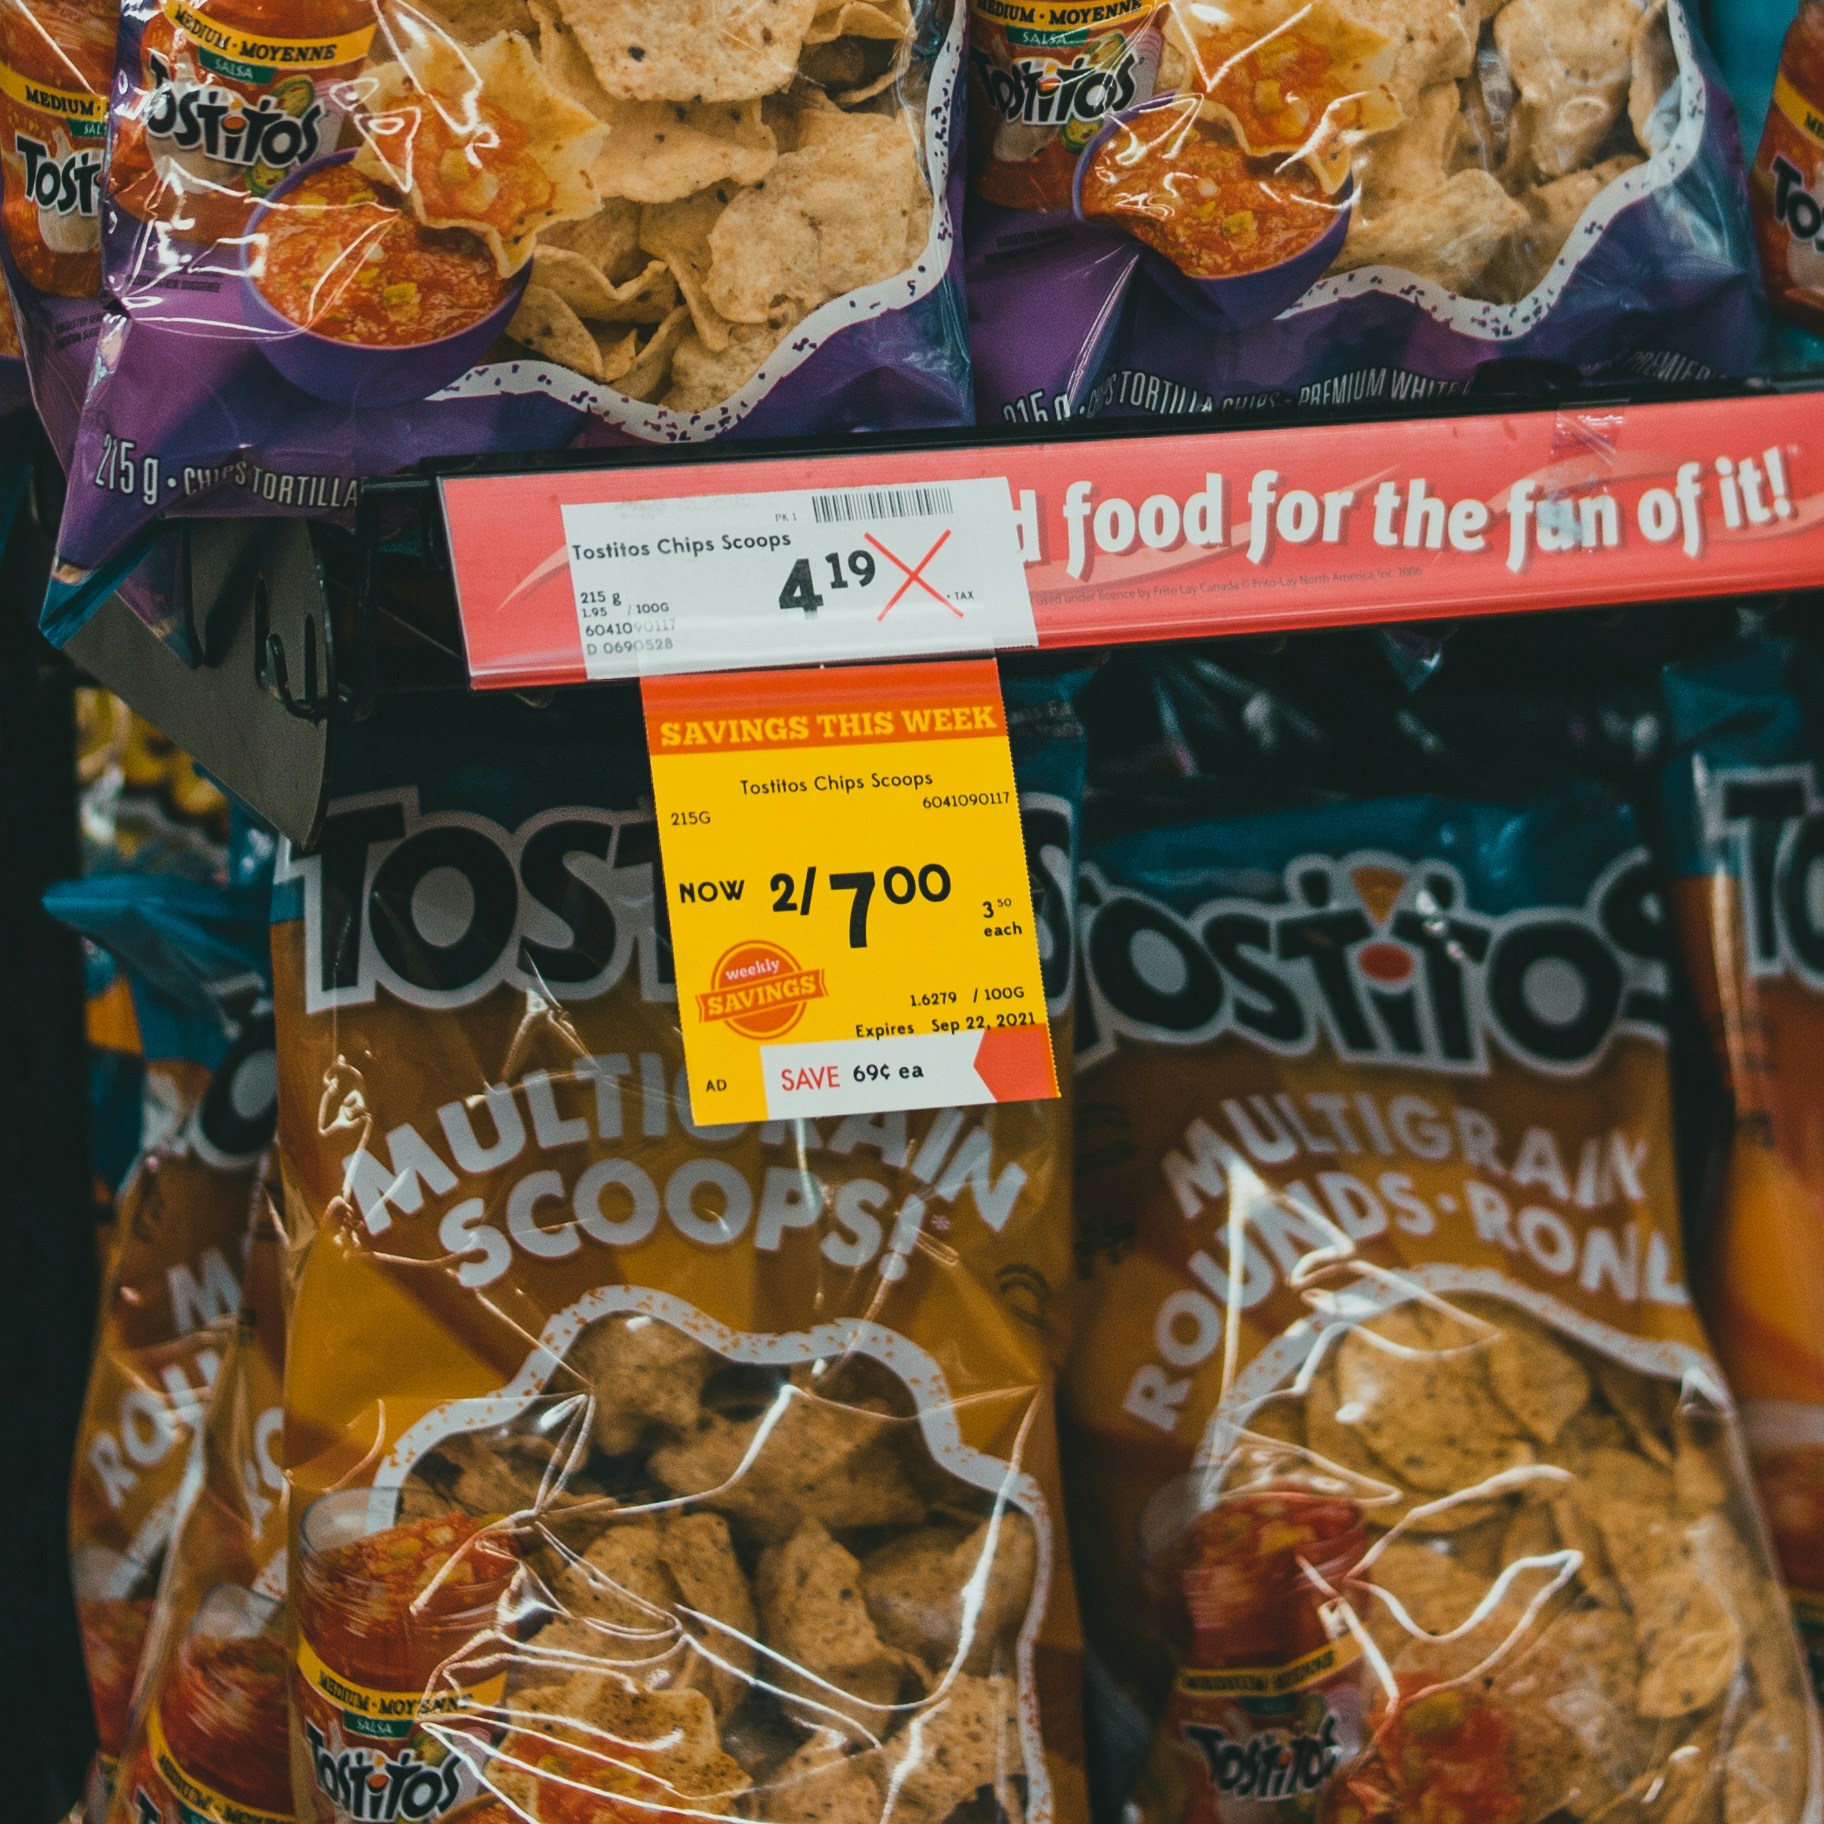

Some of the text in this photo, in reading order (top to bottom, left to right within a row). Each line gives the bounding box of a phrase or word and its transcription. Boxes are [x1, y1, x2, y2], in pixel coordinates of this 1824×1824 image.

[175, 5, 337, 62] MEDIUM MOYENNE
[1022, 31, 1067, 45] SALSA
[214, 58, 254, 80] SALSA
[26, 85, 94, 116] MEDIUM
[15, 131, 102, 216] TOST
[95, 433, 136, 495] 215
[143, 457, 160, 505] g
[775, 513, 789, 522] PK
[1063, 472, 1223, 580] food
[1246, 469, 1353, 565] for
[1373, 478, 1488, 551] the
[1506, 479, 1618, 573] fun
[1638, 462, 1704, 557] of
[1715, 446, 1793, 528] it!
[573, 533, 792, 560] Tostitos Chips Scoops
[580, 590, 622, 607] 215 g
[954, 590, 974, 601] TAX
[582, 607, 607, 618] 1.95
[636, 602, 670, 614] 100G
[585, 619, 676, 637] 6041090117
[587, 643, 597, 656] D
[660, 716, 809, 747] SAVINGS
[817, 711, 895, 737] THIS
[901, 705, 997, 734] WEEK
[740, 772, 933, 796] Tostitos Chips Scoops
[922, 791, 1010, 809] 6041090117
[671, 811, 711, 826] 215G
[679, 879, 745, 904] NOW
[983, 922, 1023, 937] each
[725, 957, 780, 981] weekly
[707, 975, 816, 1016] SAVINGS
[910, 992, 958, 1007] 1.6279
[984, 987, 1025, 1001] 100G
[855, 1012, 1035, 1040] Expires Sep 22, 2021
[705, 1079, 727, 1093] AD
[781, 1063, 924, 1091] SAVE 69¢ ea
[438, 1157, 925, 1288] SCOOPS!
[1123, 1173, 1690, 1431] ROUNDS RON
[357, 1719, 392, 1734] SALSA
